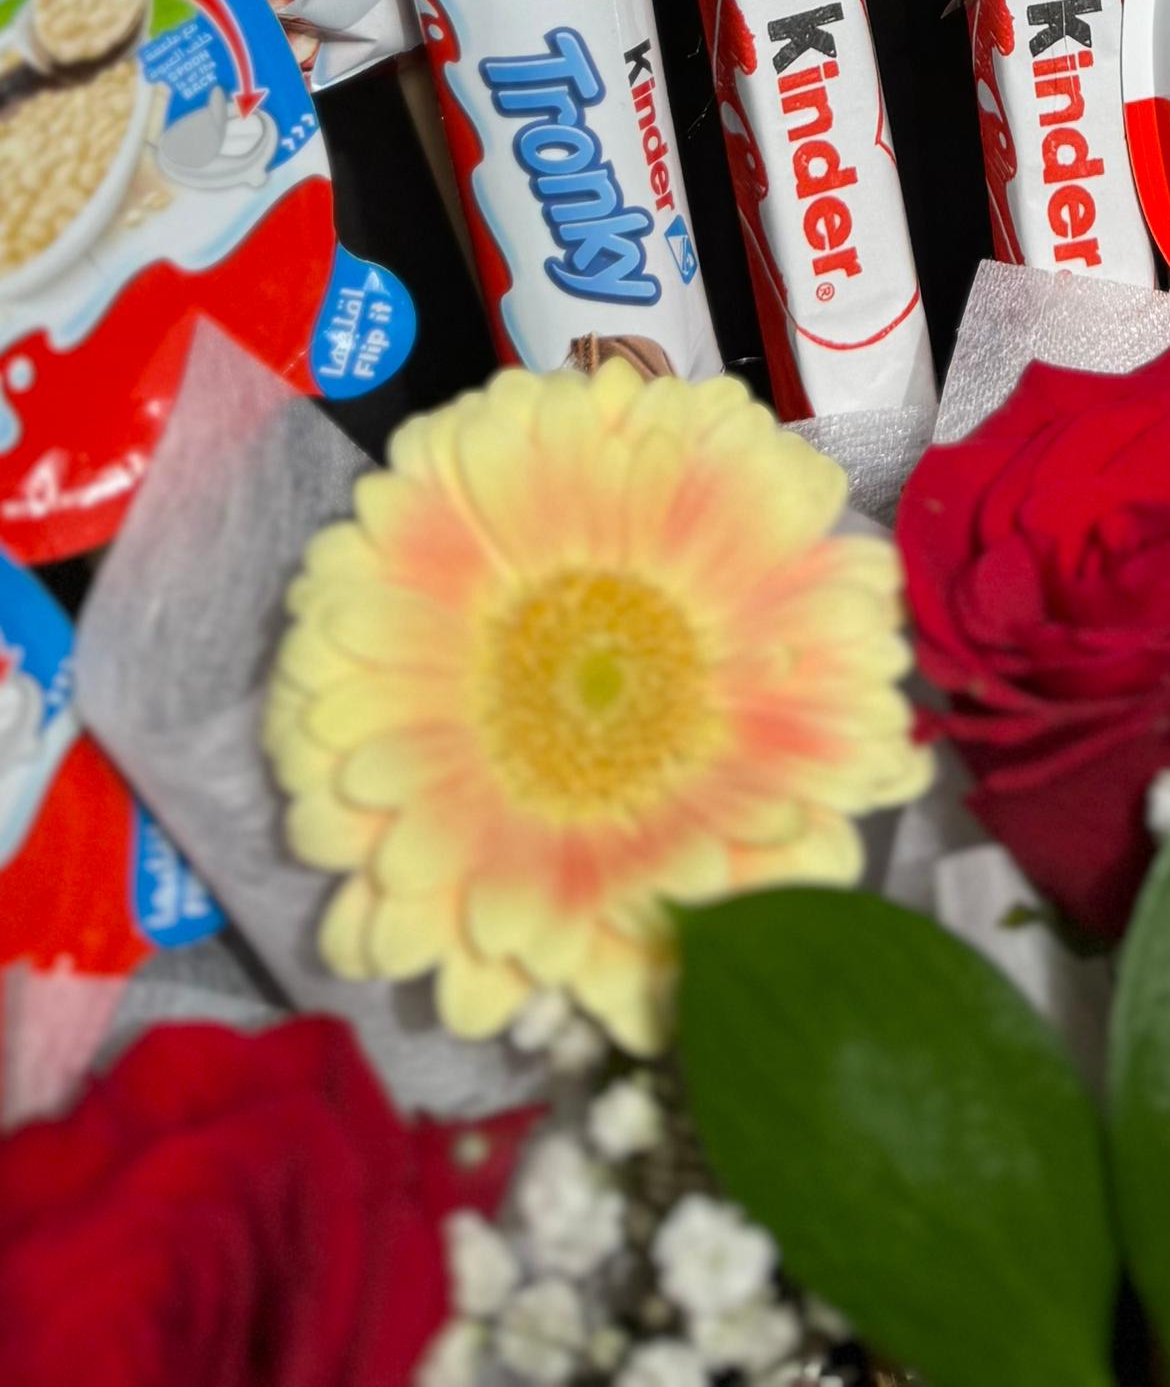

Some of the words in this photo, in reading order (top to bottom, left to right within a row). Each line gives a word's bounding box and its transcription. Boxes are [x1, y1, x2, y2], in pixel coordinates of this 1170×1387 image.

[478, 26, 662, 306] Tronky
[624, 38, 675, 212] Kinder
[767, 1, 865, 281] Kinder
[353, 328, 391, 378] Flip
[368, 300, 393, 323] it
